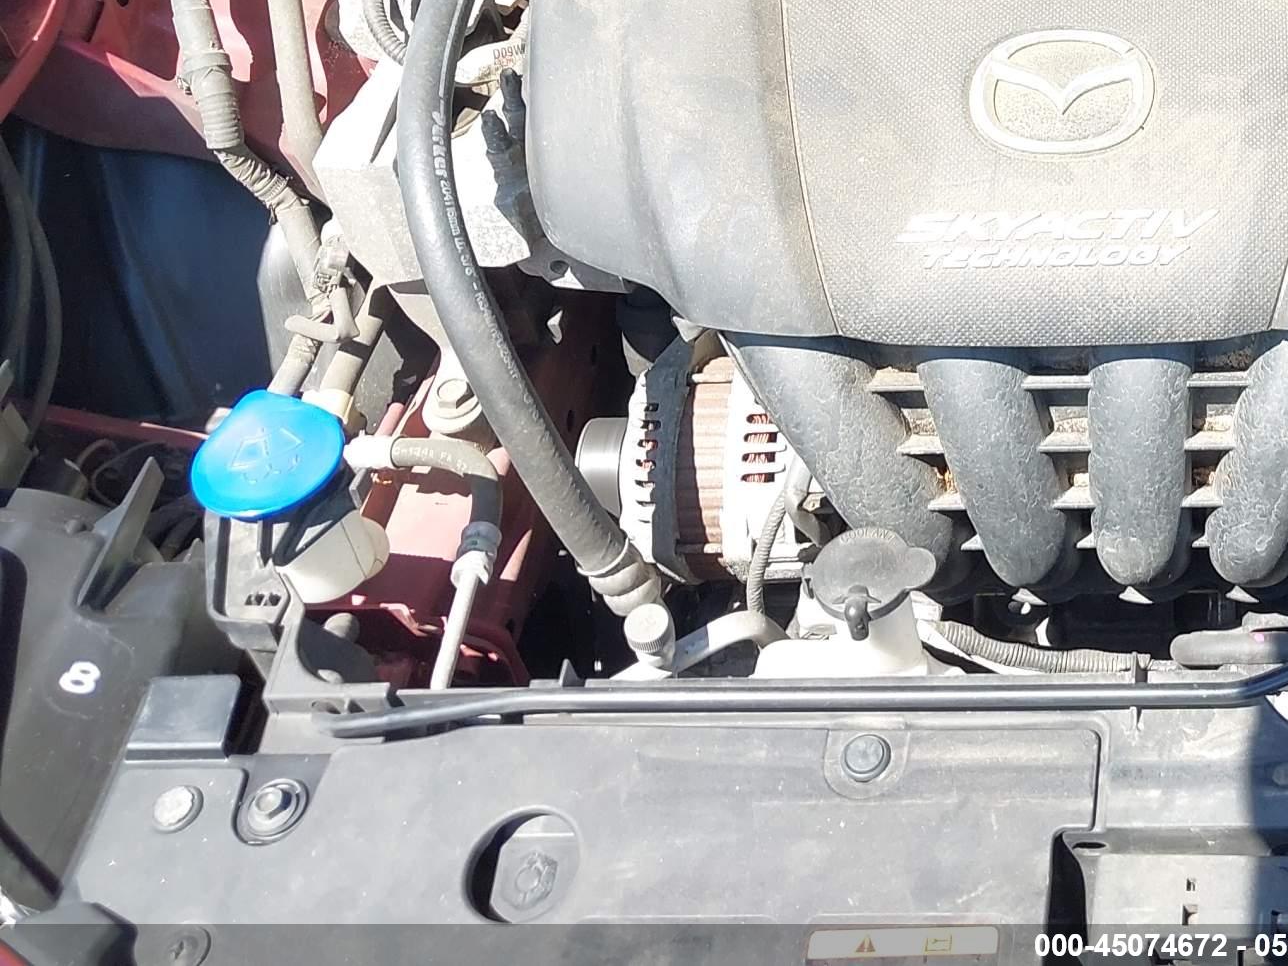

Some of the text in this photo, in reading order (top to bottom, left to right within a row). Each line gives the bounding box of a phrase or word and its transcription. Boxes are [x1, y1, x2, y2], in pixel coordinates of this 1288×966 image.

[895, 209, 1221, 243] SKYACTIV
[922, 245, 1192, 269] TECHNOLOGY
[58, 660, 101, 694] 8
